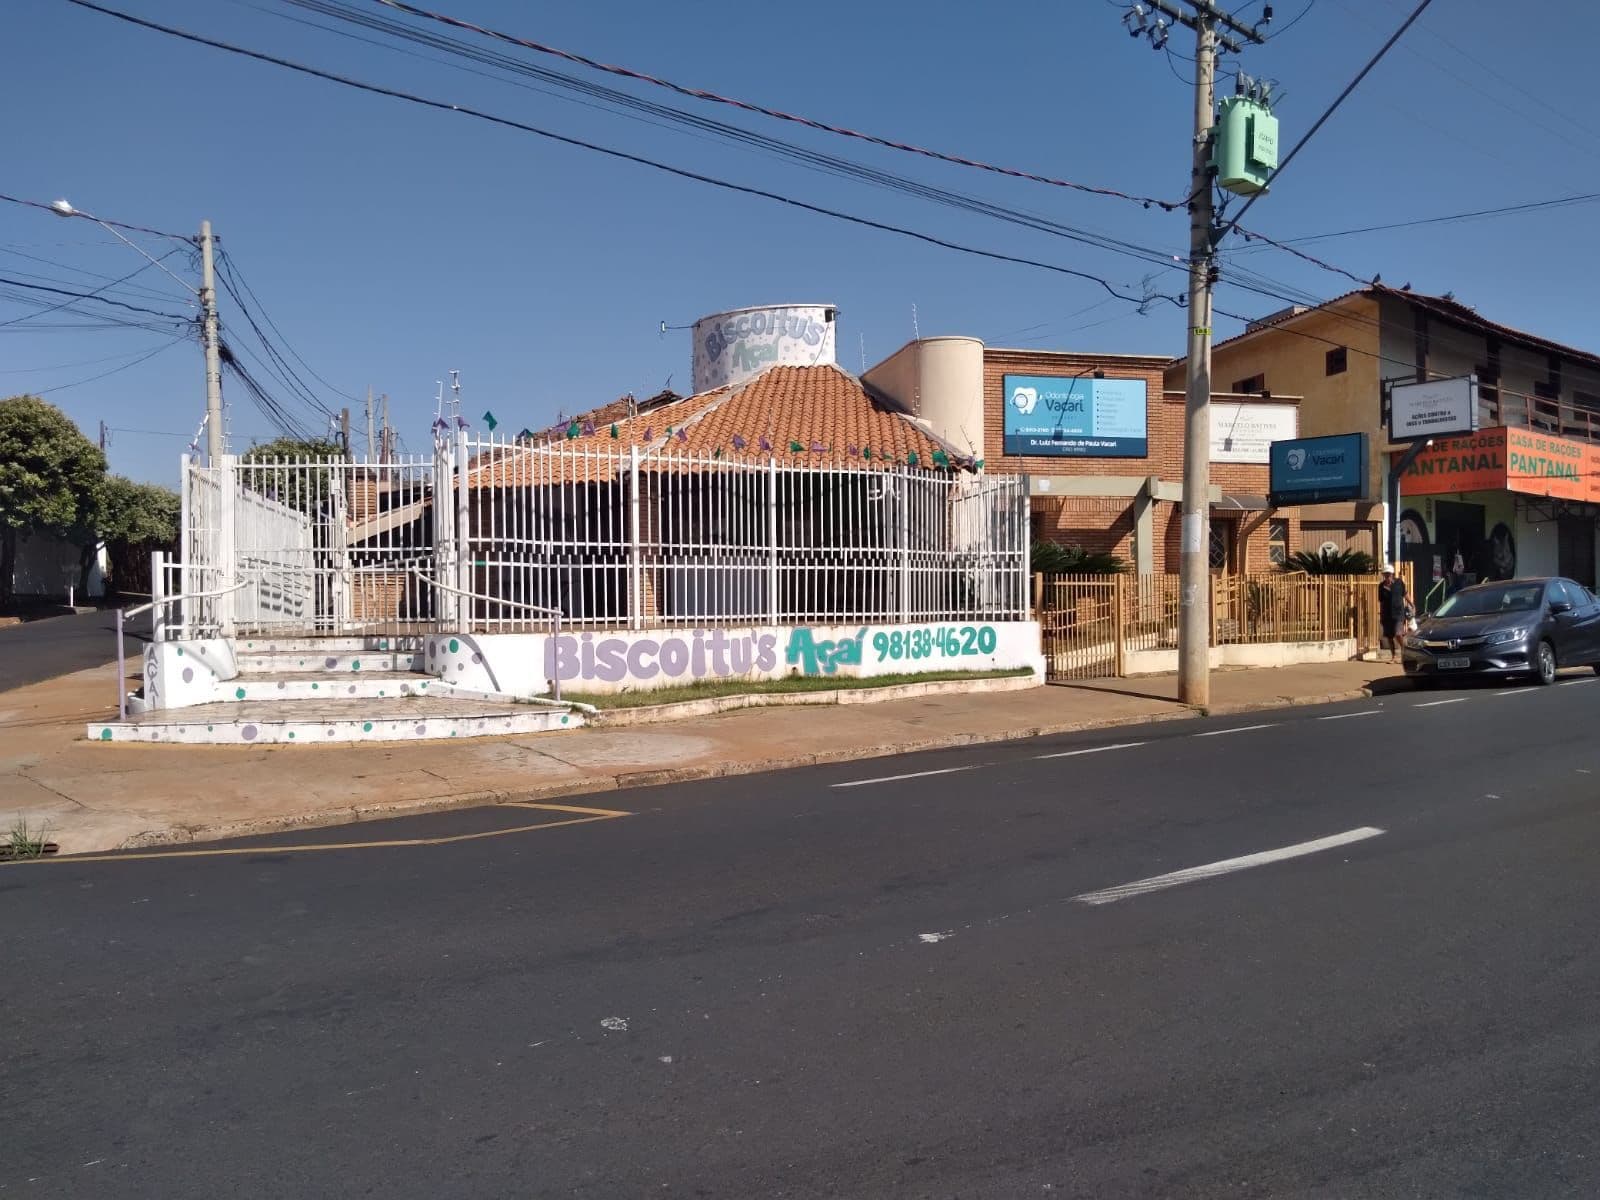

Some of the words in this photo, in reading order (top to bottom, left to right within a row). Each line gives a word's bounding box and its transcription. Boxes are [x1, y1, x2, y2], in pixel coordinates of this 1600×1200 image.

[1045, 399, 1084, 412] Vacari
[1433, 441, 1449, 452] DE
[1510, 433, 1533, 449] CASA
[1535, 438, 1547, 452] DE
[1406, 453, 1504, 477] ANTANAL
[1510, 452, 1581, 483] PANTANAL
[543, 628, 777, 682] Biscoitu's
[785, 626, 869, 676] Açaí
